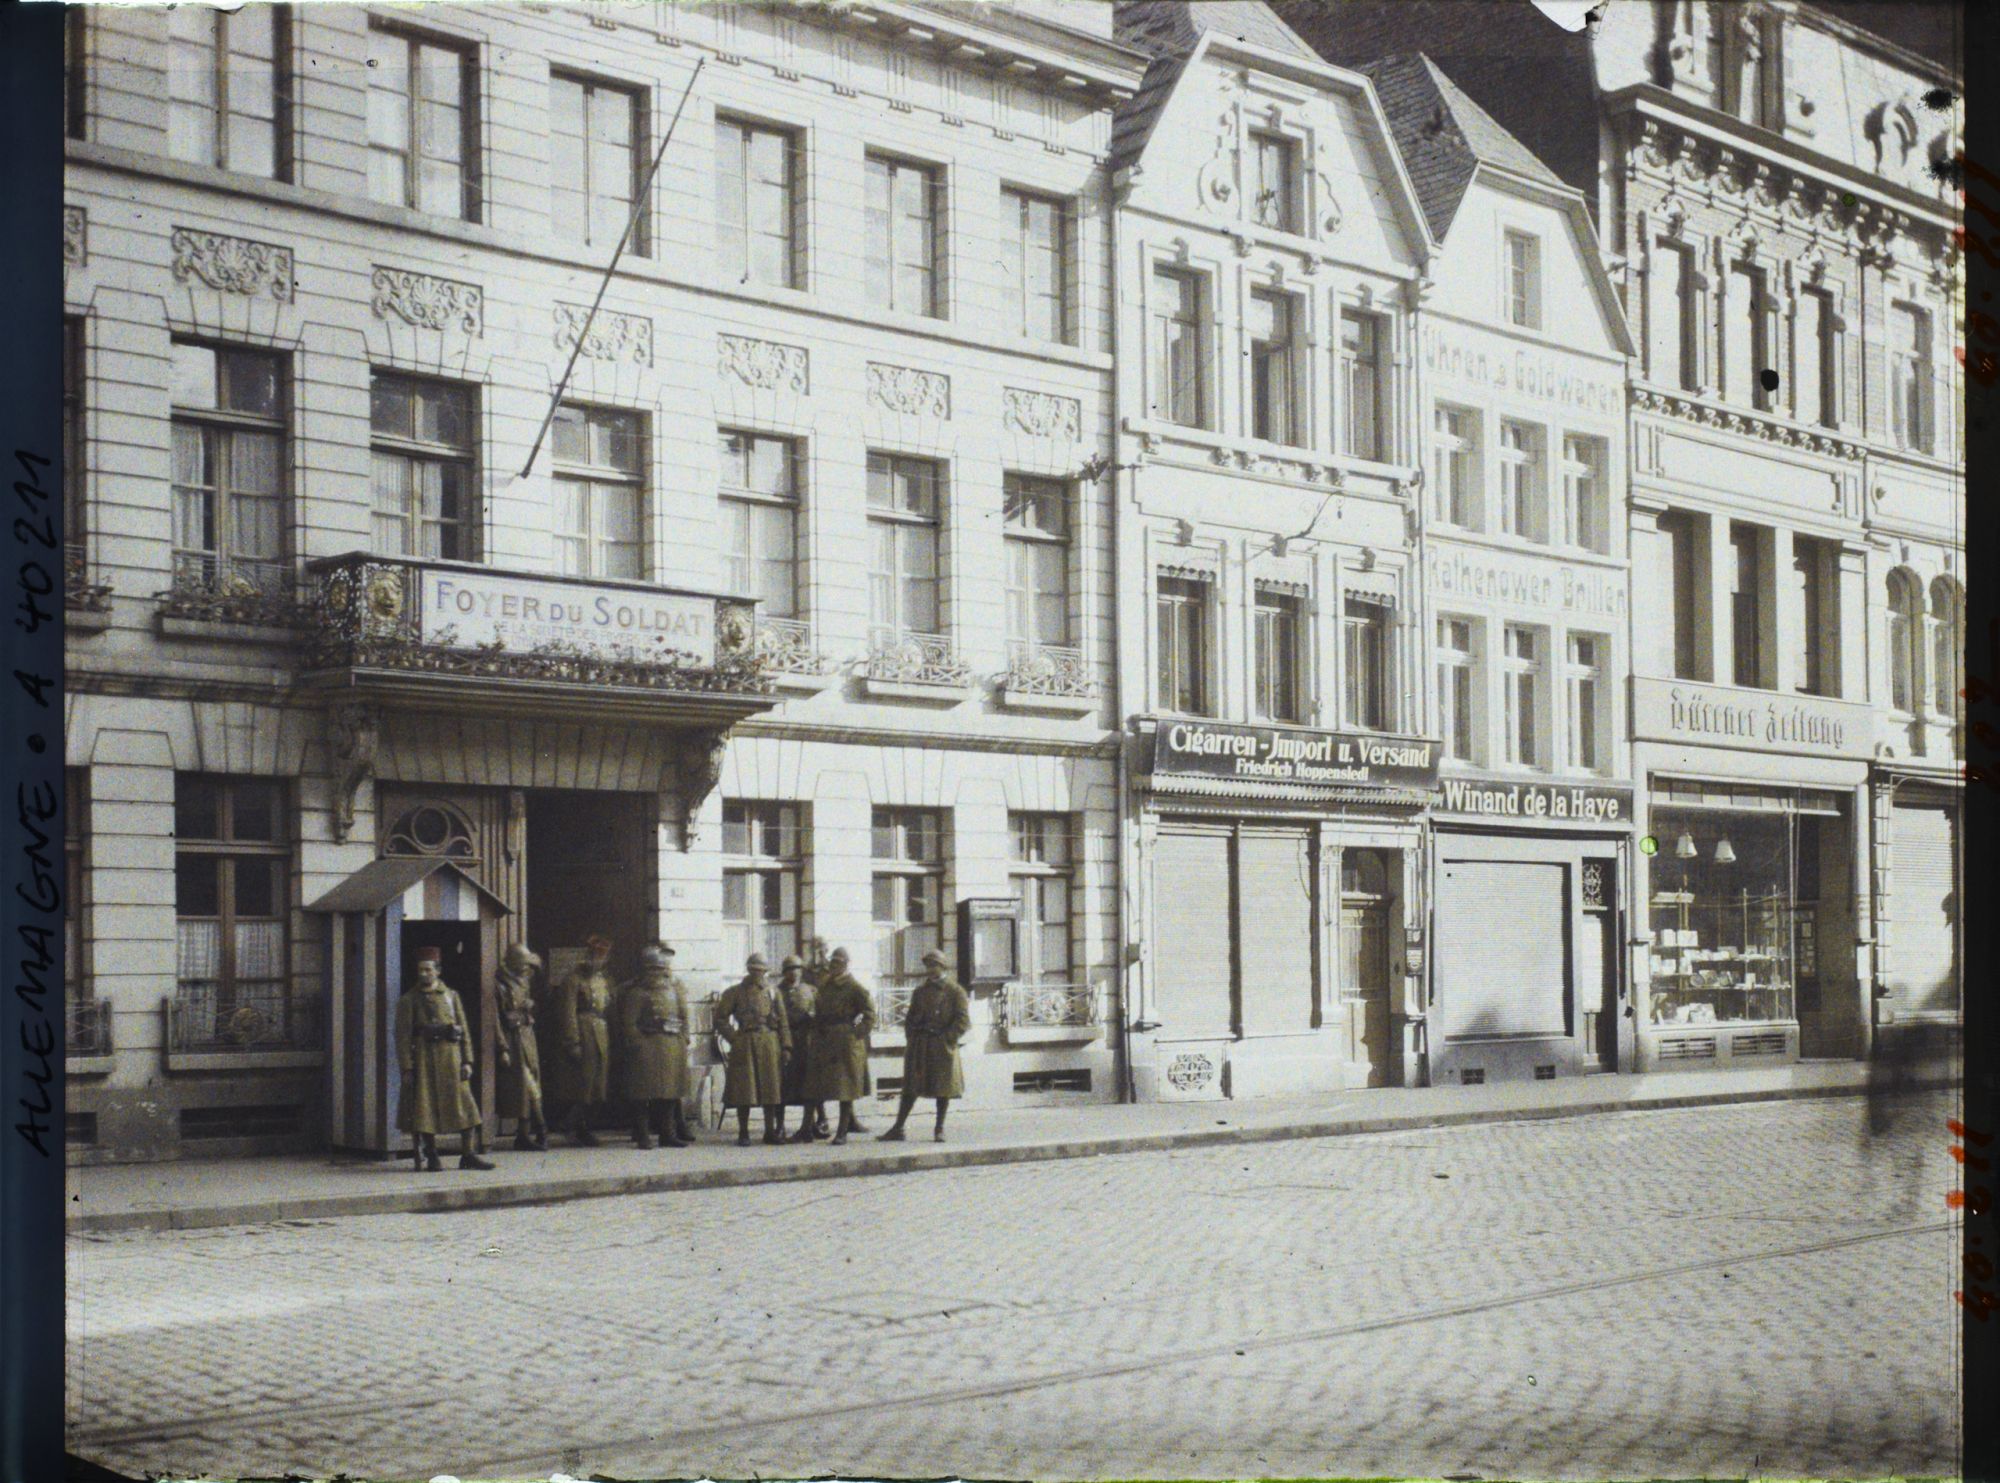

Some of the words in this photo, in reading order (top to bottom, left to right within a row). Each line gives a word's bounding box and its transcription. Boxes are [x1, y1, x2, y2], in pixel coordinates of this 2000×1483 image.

[13, 449, 57, 633] 40211
[436, 580, 541, 622] FOYER
[549, 602, 582, 624] DU
[593, 596, 708, 636] SOLDAT
[1560, 566, 1627, 614] Brillen
[14, 668, 57, 707] A
[1671, 687, 1756, 737] Dürener
[1766, 703, 1843, 749] Zeitung
[1235, 757, 1293, 777] Friedrich
[1338, 742, 1354, 764] u.
[1358, 739, 1430, 768] Versand
[1443, 780, 1519, 815] Winand
[1524, 787, 1547, 816] de
[1550, 788, 1568, 818] la
[1570, 789, 1619, 823] Haye
[15, 780, 59, 1159] ALLEMAGNE
